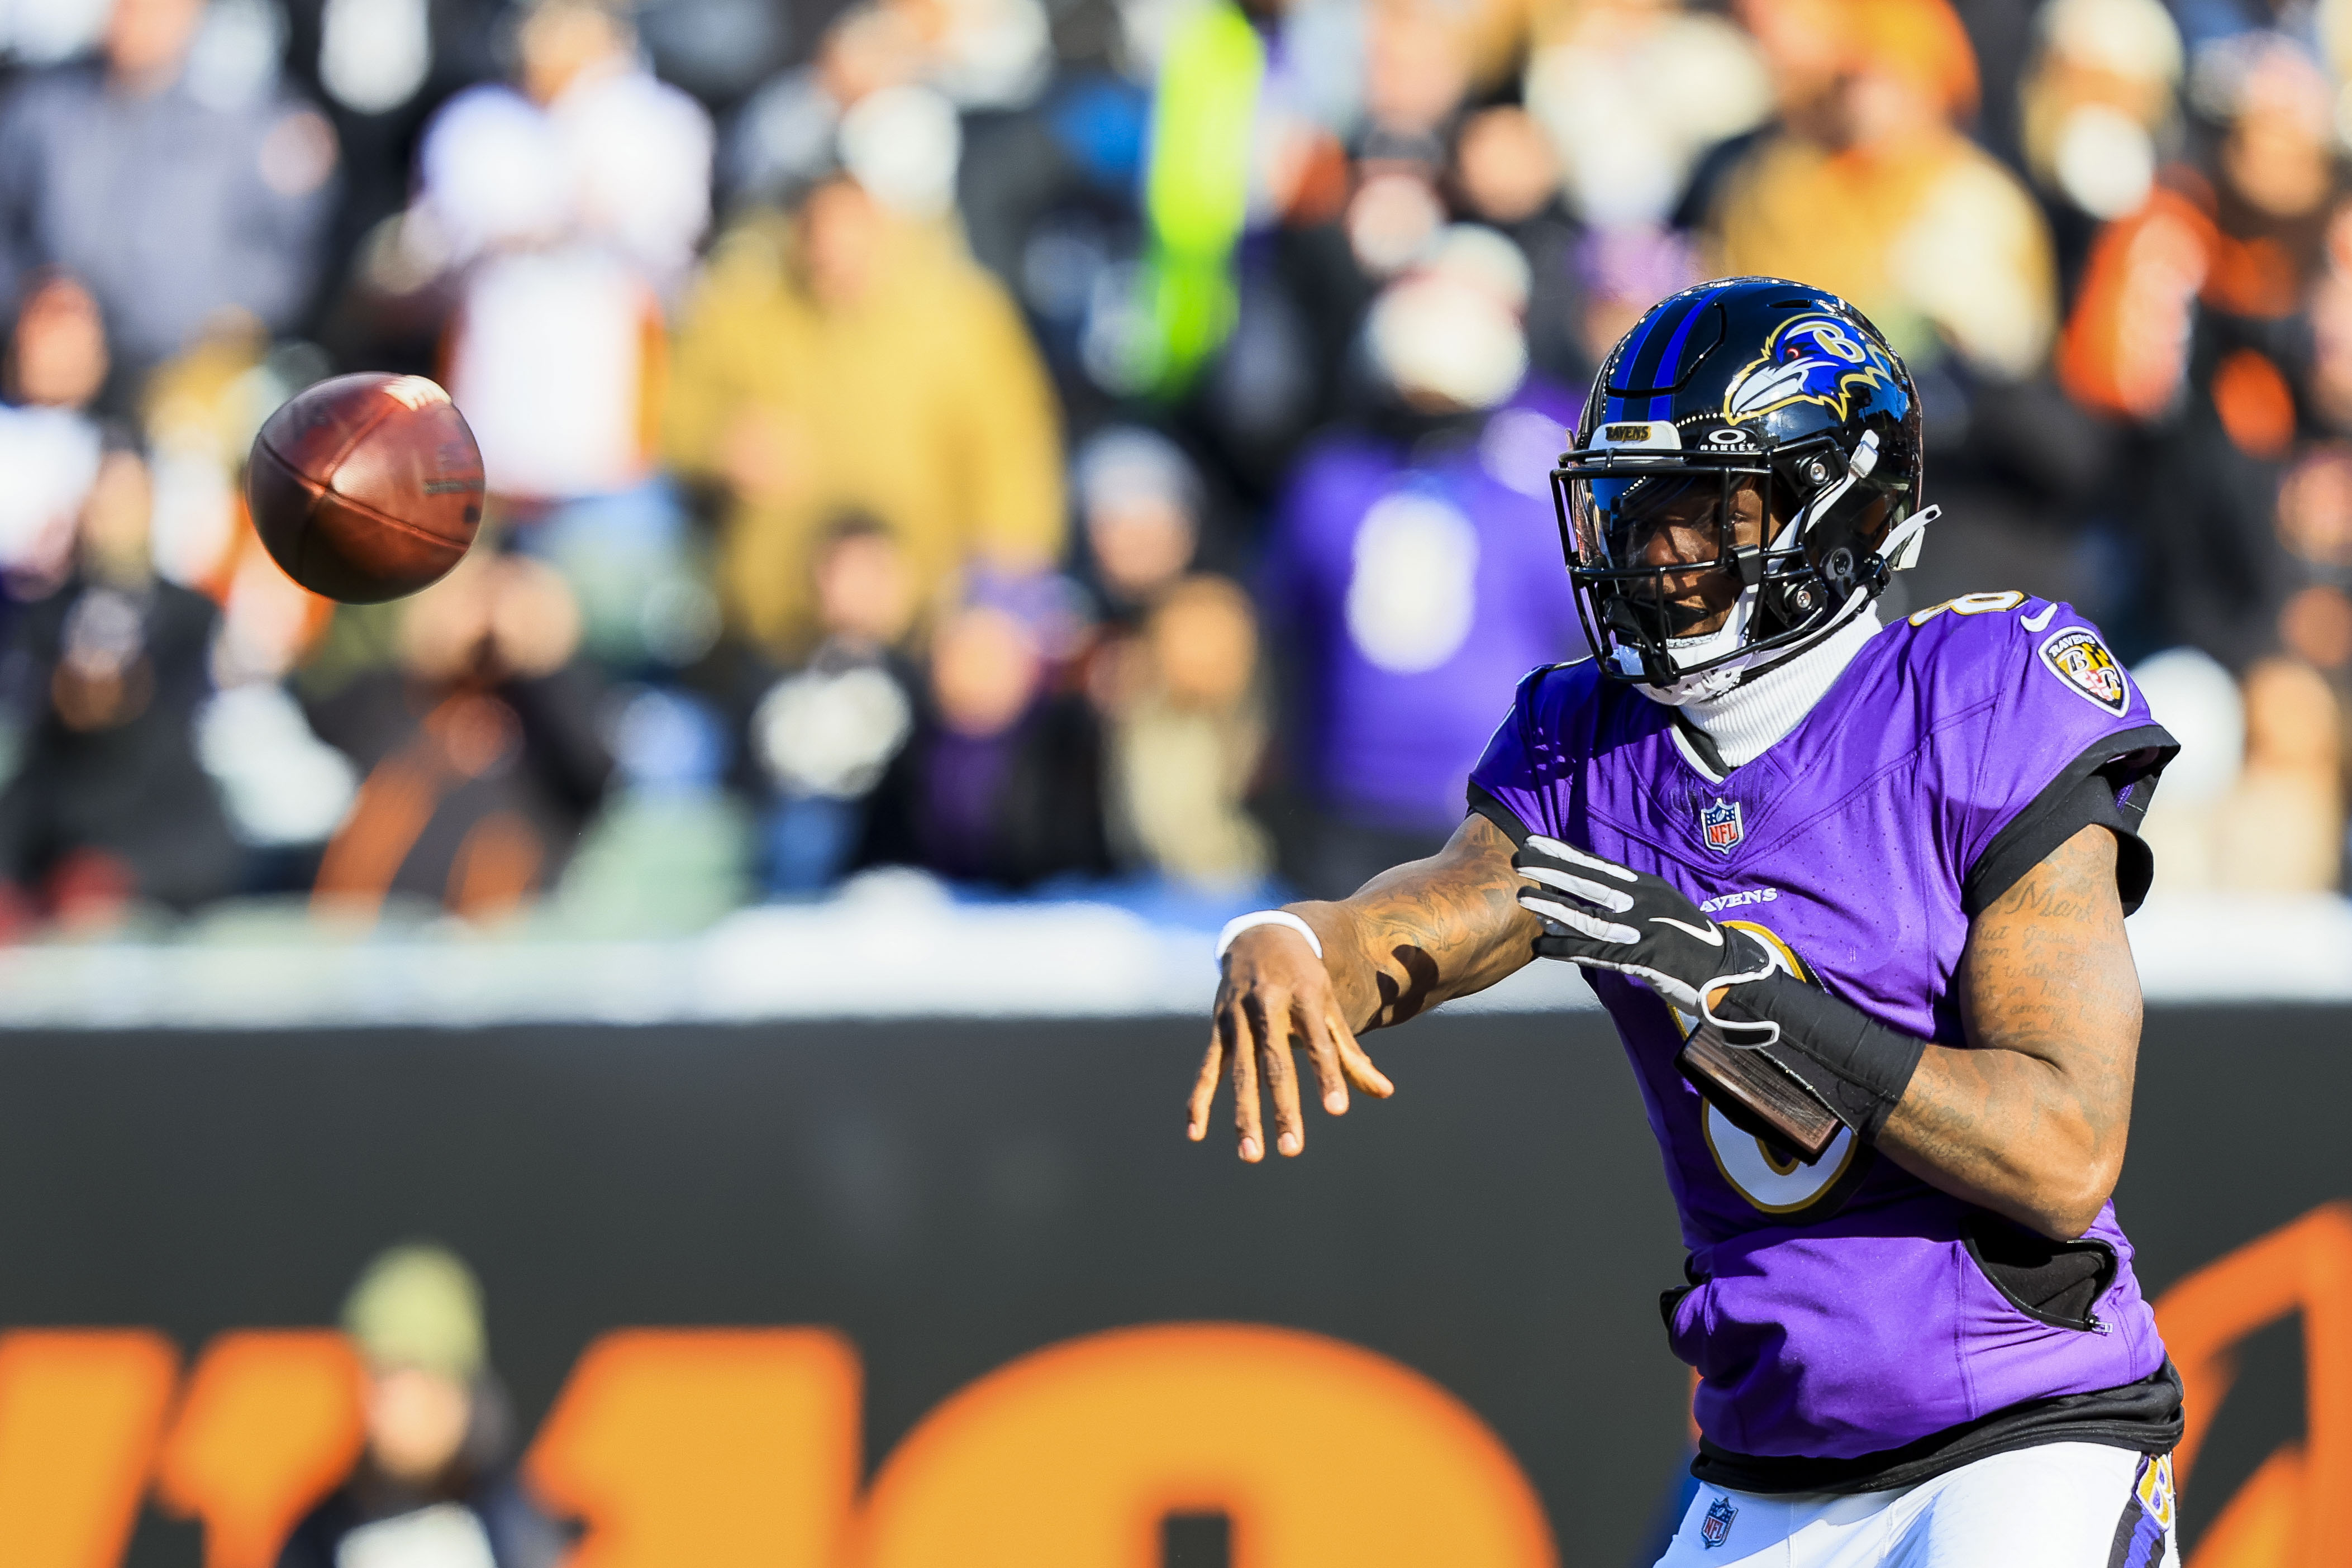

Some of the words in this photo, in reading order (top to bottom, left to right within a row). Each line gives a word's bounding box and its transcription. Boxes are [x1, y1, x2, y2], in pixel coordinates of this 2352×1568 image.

[1784, 321, 1866, 363] B
[1605, 426, 1652, 442] RAVENS
[1699, 443, 1756, 451] OAKLEY
[2048, 634, 2096, 657] RAVENS
[1709, 823, 1738, 844] NFL
[1699, 887, 1778, 913] AVENS
[1703, 1516, 1724, 1540] NFL
